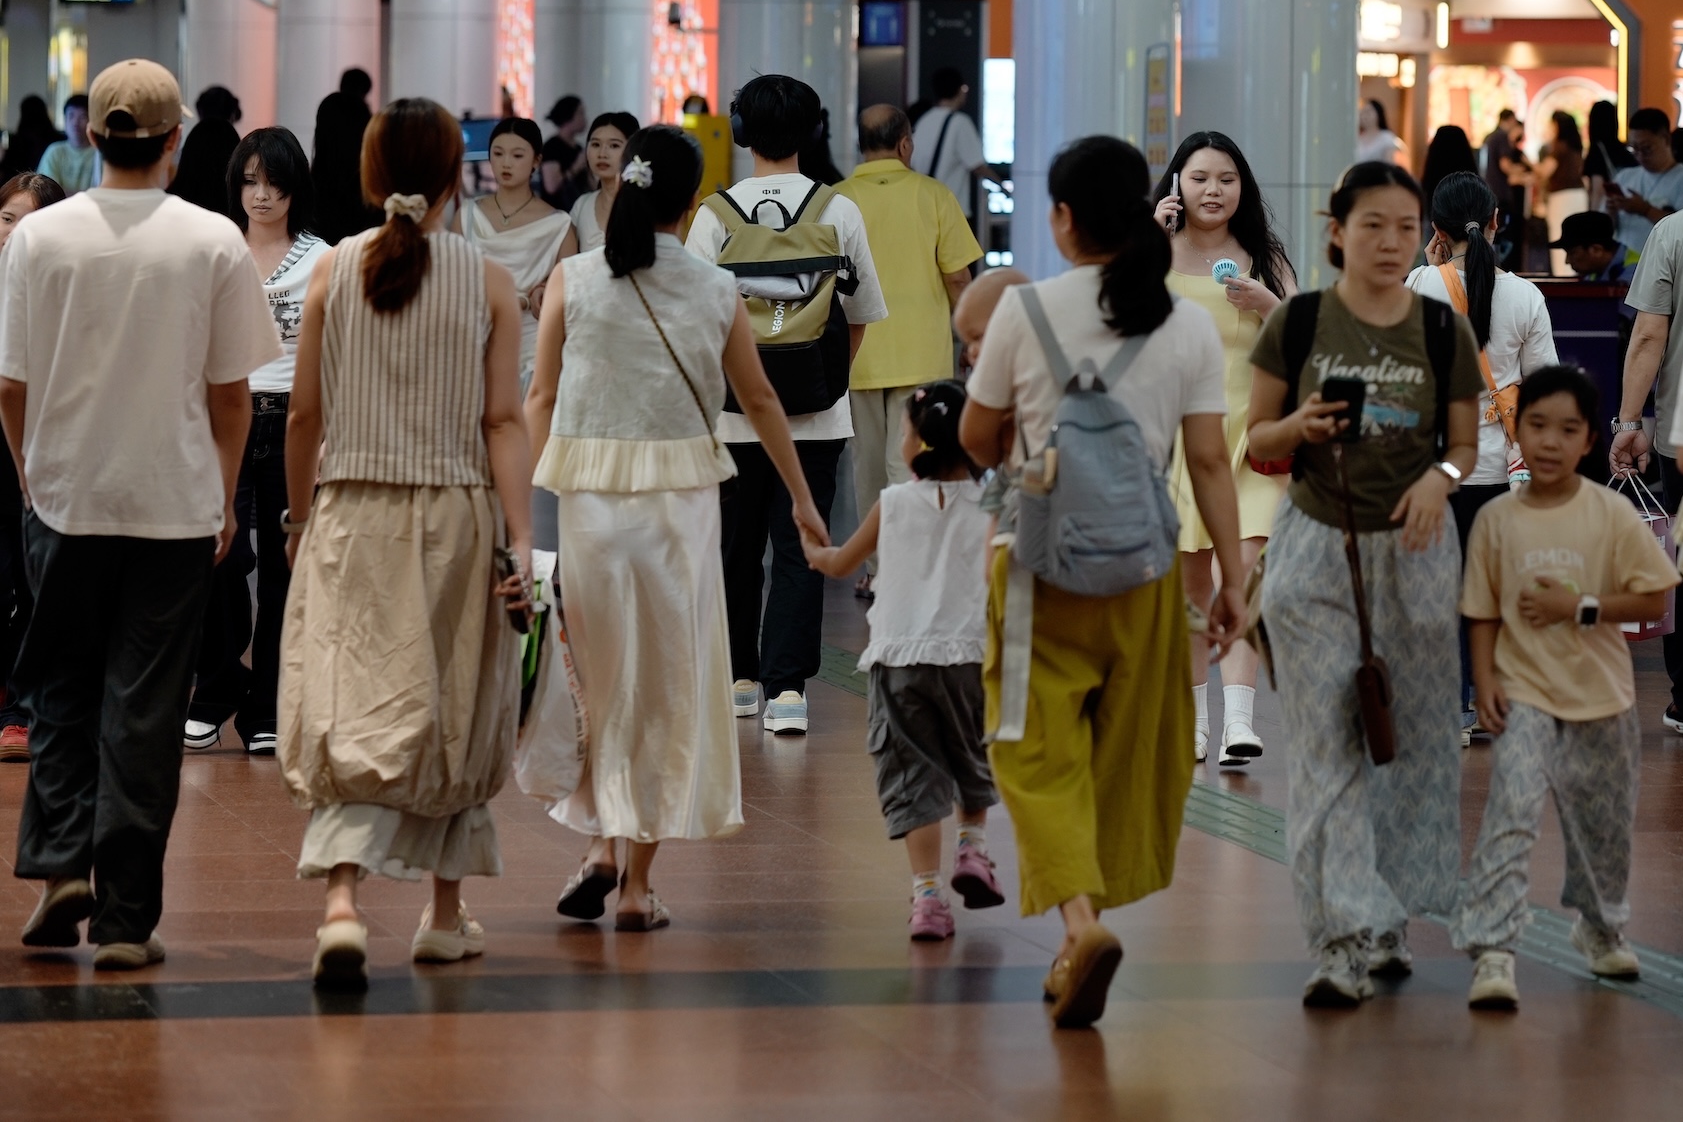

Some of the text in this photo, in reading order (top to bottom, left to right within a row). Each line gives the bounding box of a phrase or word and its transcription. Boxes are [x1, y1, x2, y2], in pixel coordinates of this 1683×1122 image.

[771, 300, 786, 335] LEGION
[1311, 353, 1427, 387] Vacation
[1515, 548, 1585, 575] LEMON
